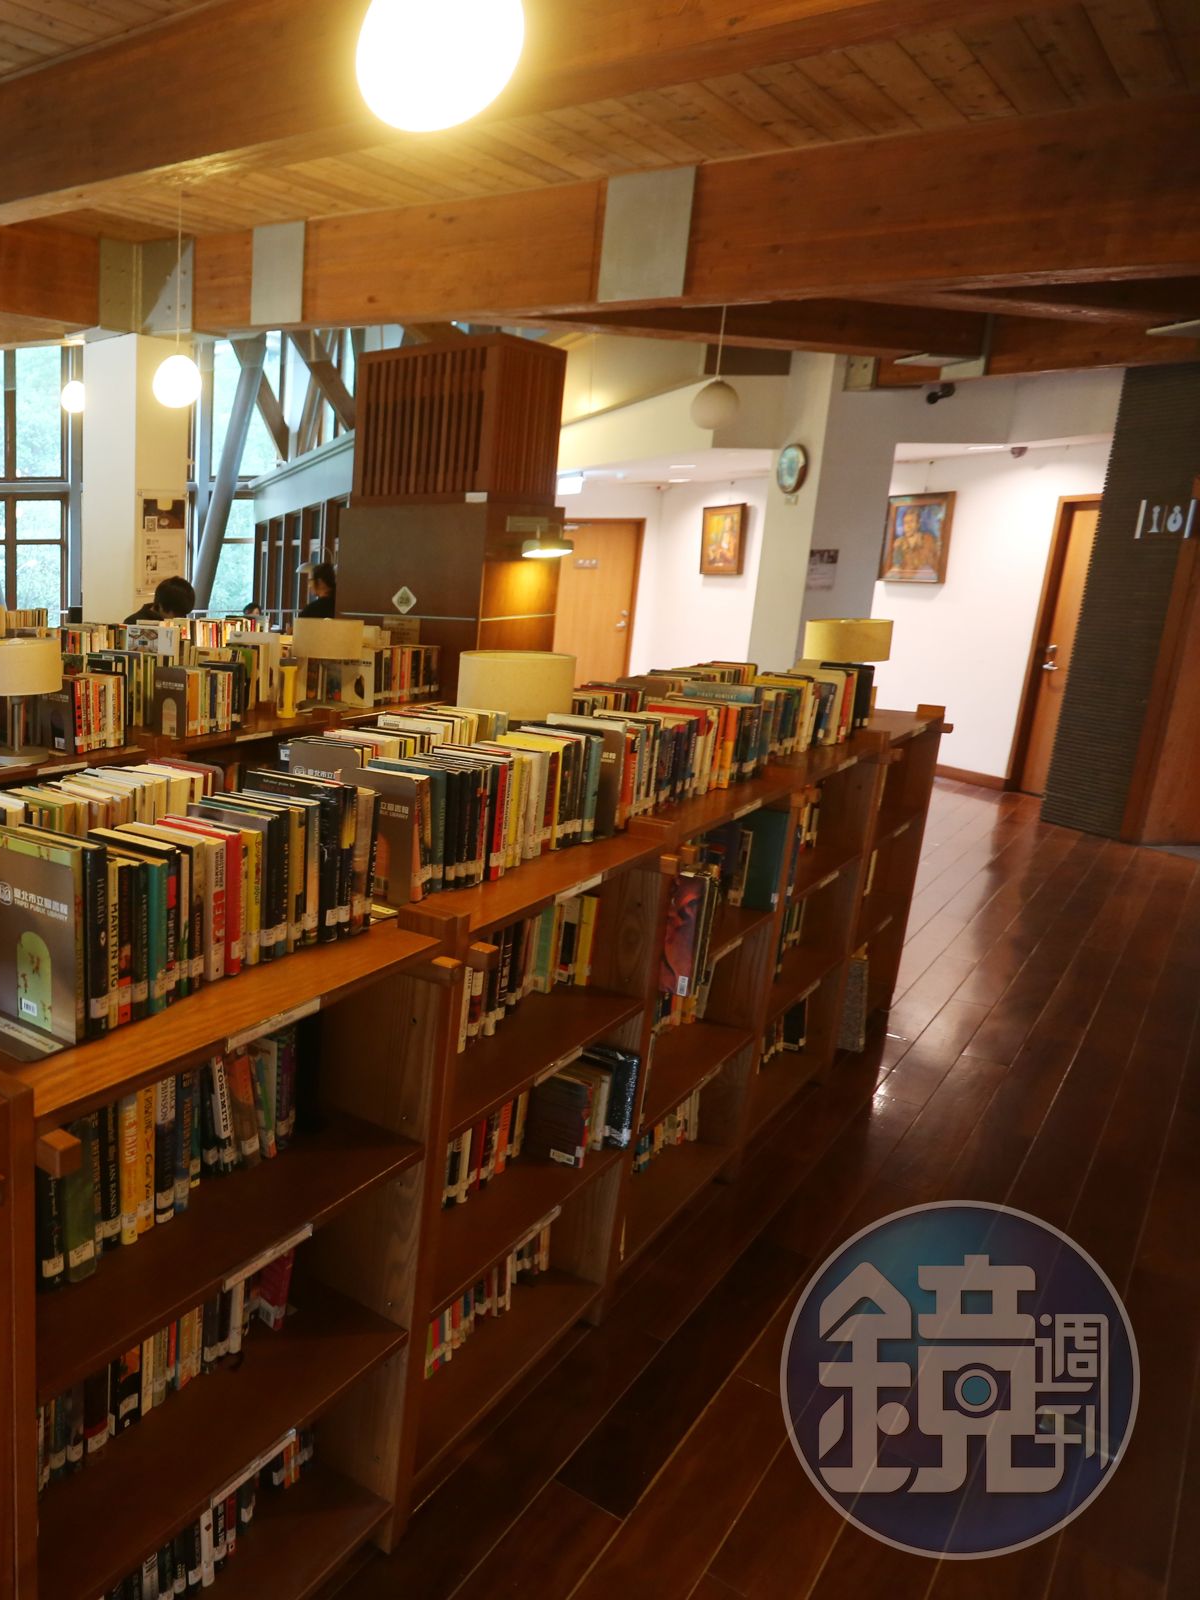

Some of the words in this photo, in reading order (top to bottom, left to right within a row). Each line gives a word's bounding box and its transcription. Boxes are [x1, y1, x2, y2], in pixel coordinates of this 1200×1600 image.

[96, 877, 104, 925] HARRIS
[110, 902, 119, 961] MARTYN
[110, 961, 119, 989] PIG
[160, 1080, 169, 1121] OBINSON
[216, 1063, 229, 1132] YOSEMITE
[124, 1127, 137, 1165] WATCH
